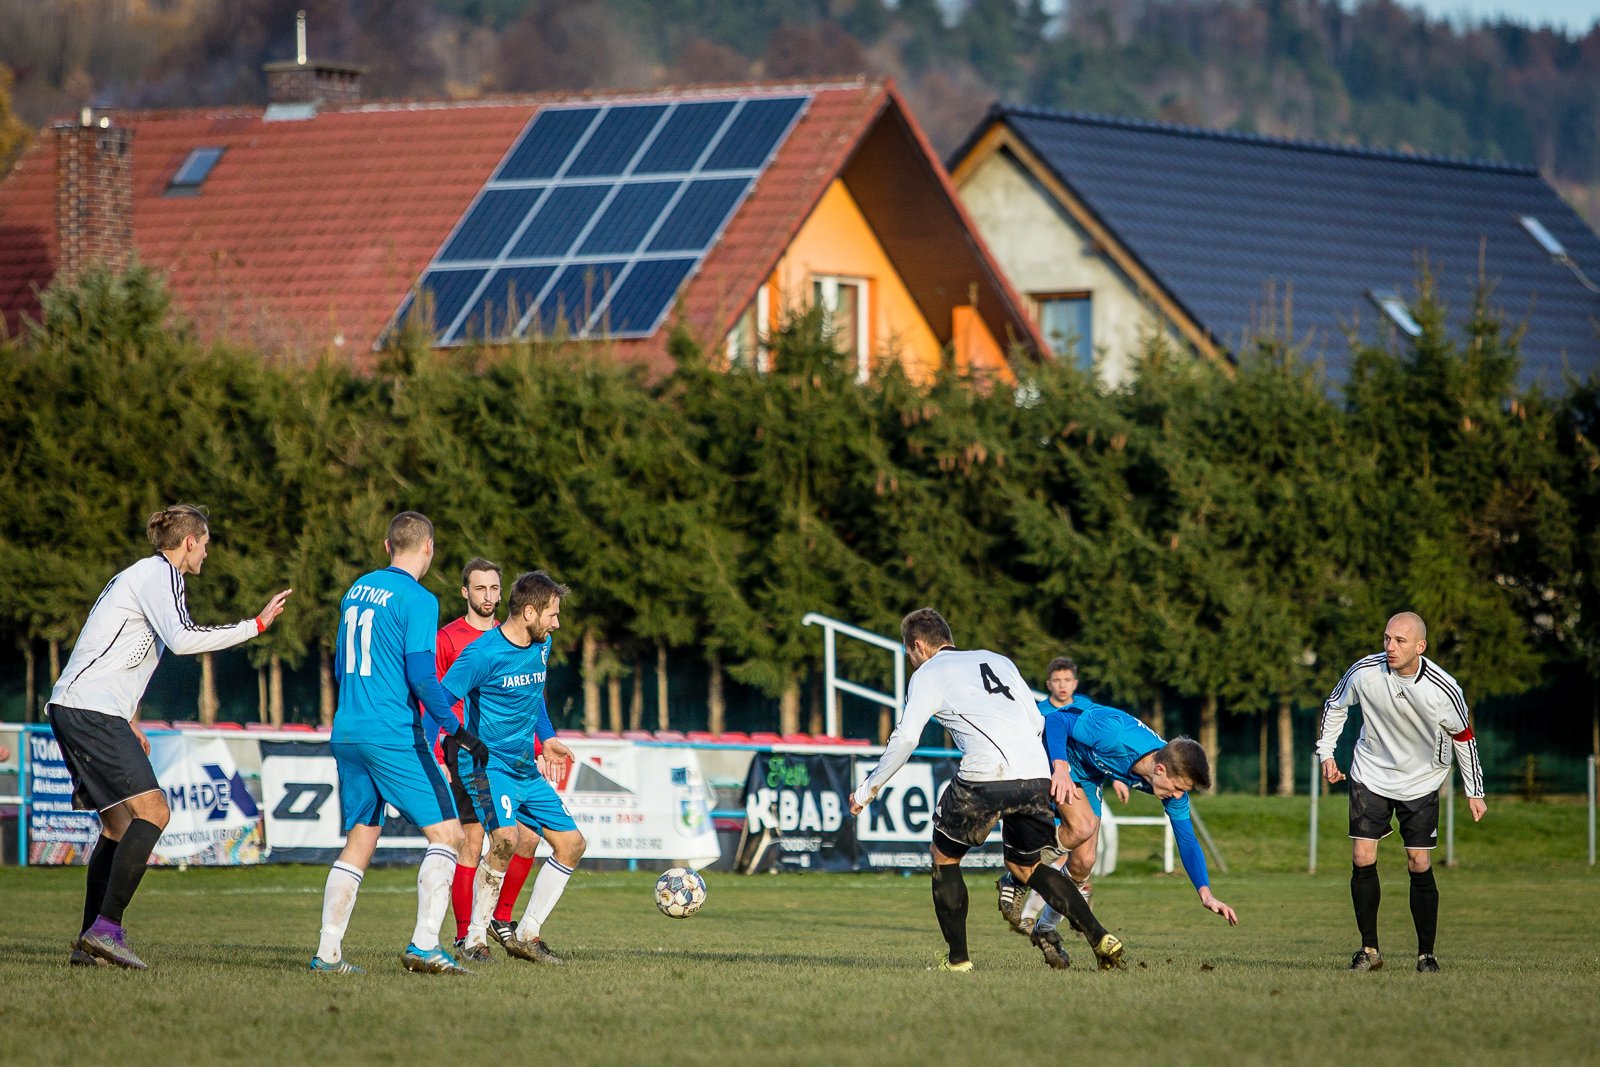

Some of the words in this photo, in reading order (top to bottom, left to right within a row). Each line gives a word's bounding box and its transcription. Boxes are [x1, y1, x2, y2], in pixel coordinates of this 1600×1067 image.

[344, 605, 376, 677] 11
[979, 662, 1016, 702] 4
[30, 736, 64, 761] TOM
[500, 794, 513, 819] 9
